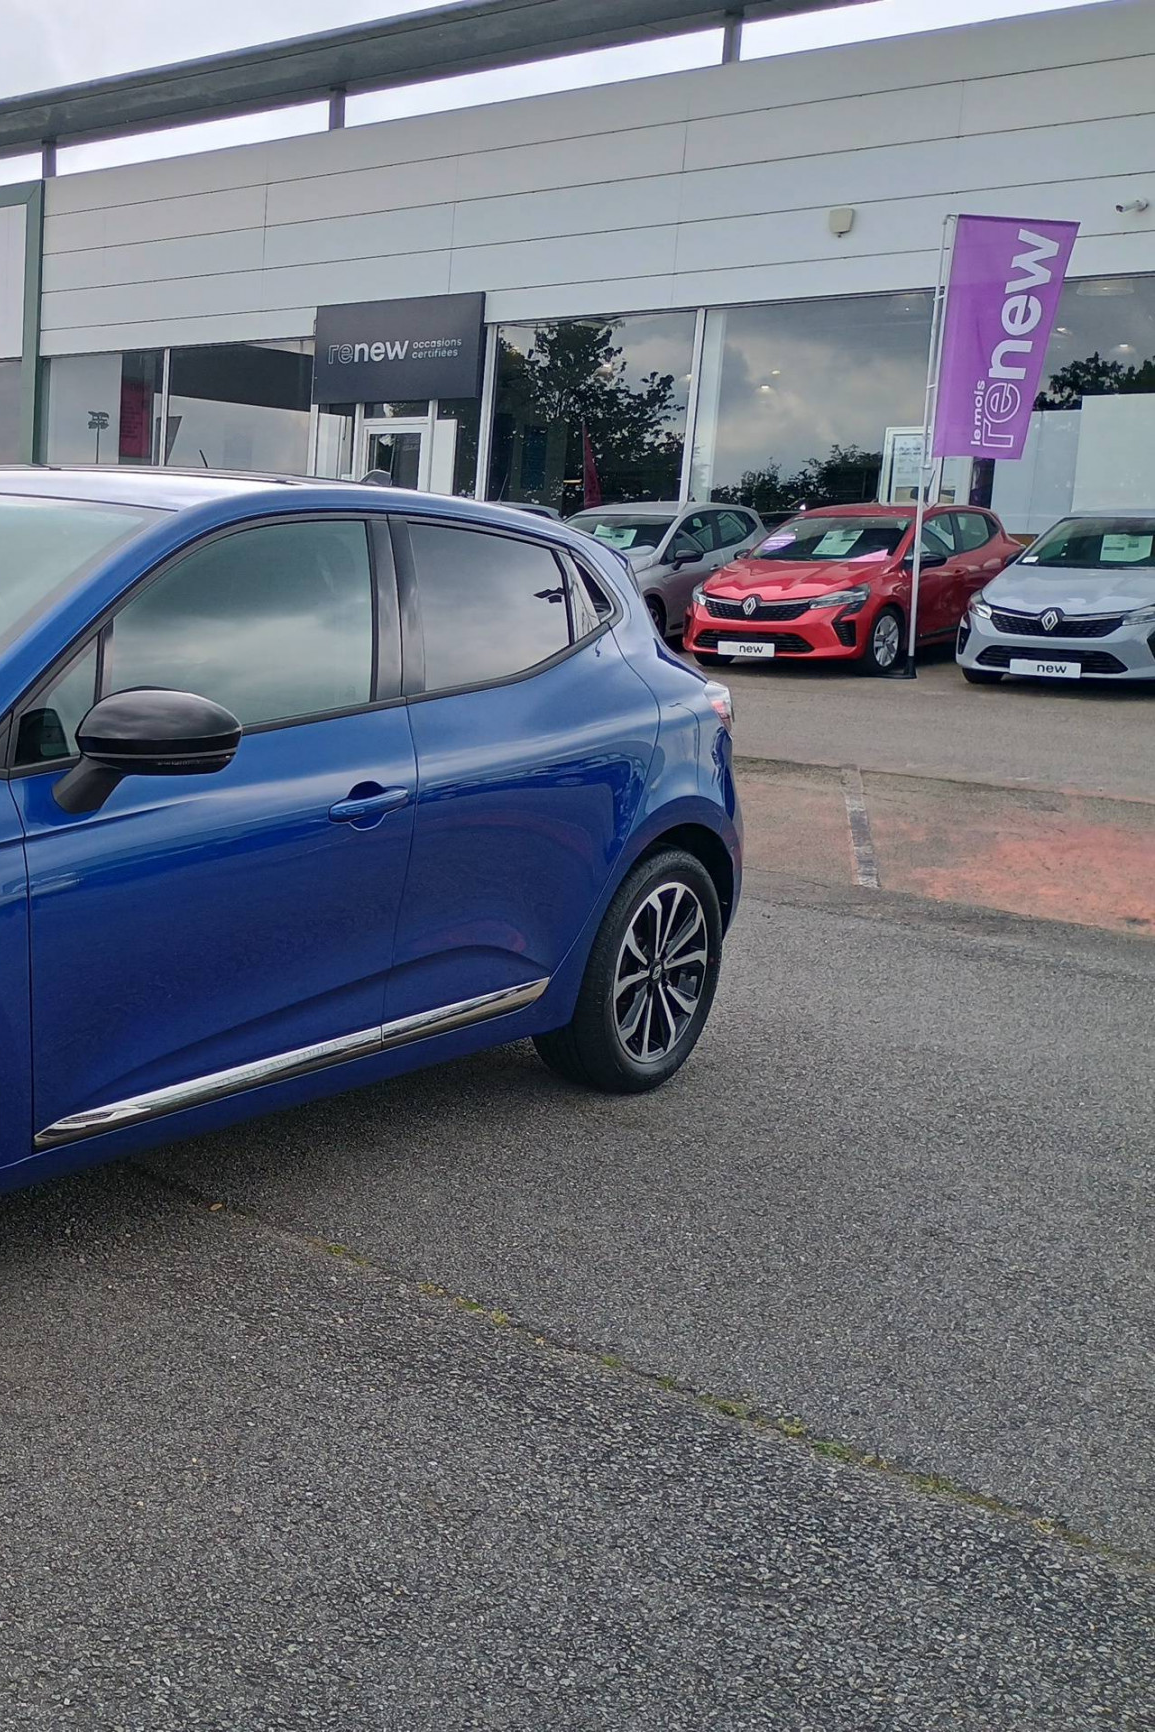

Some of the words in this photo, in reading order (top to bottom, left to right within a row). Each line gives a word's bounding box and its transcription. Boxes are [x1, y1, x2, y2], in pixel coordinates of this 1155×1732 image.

[328, 340, 409, 365] renew
[412, 338, 463, 349] occasions
[981, 228, 1060, 448] renew
[973, 380, 986, 427] mois
